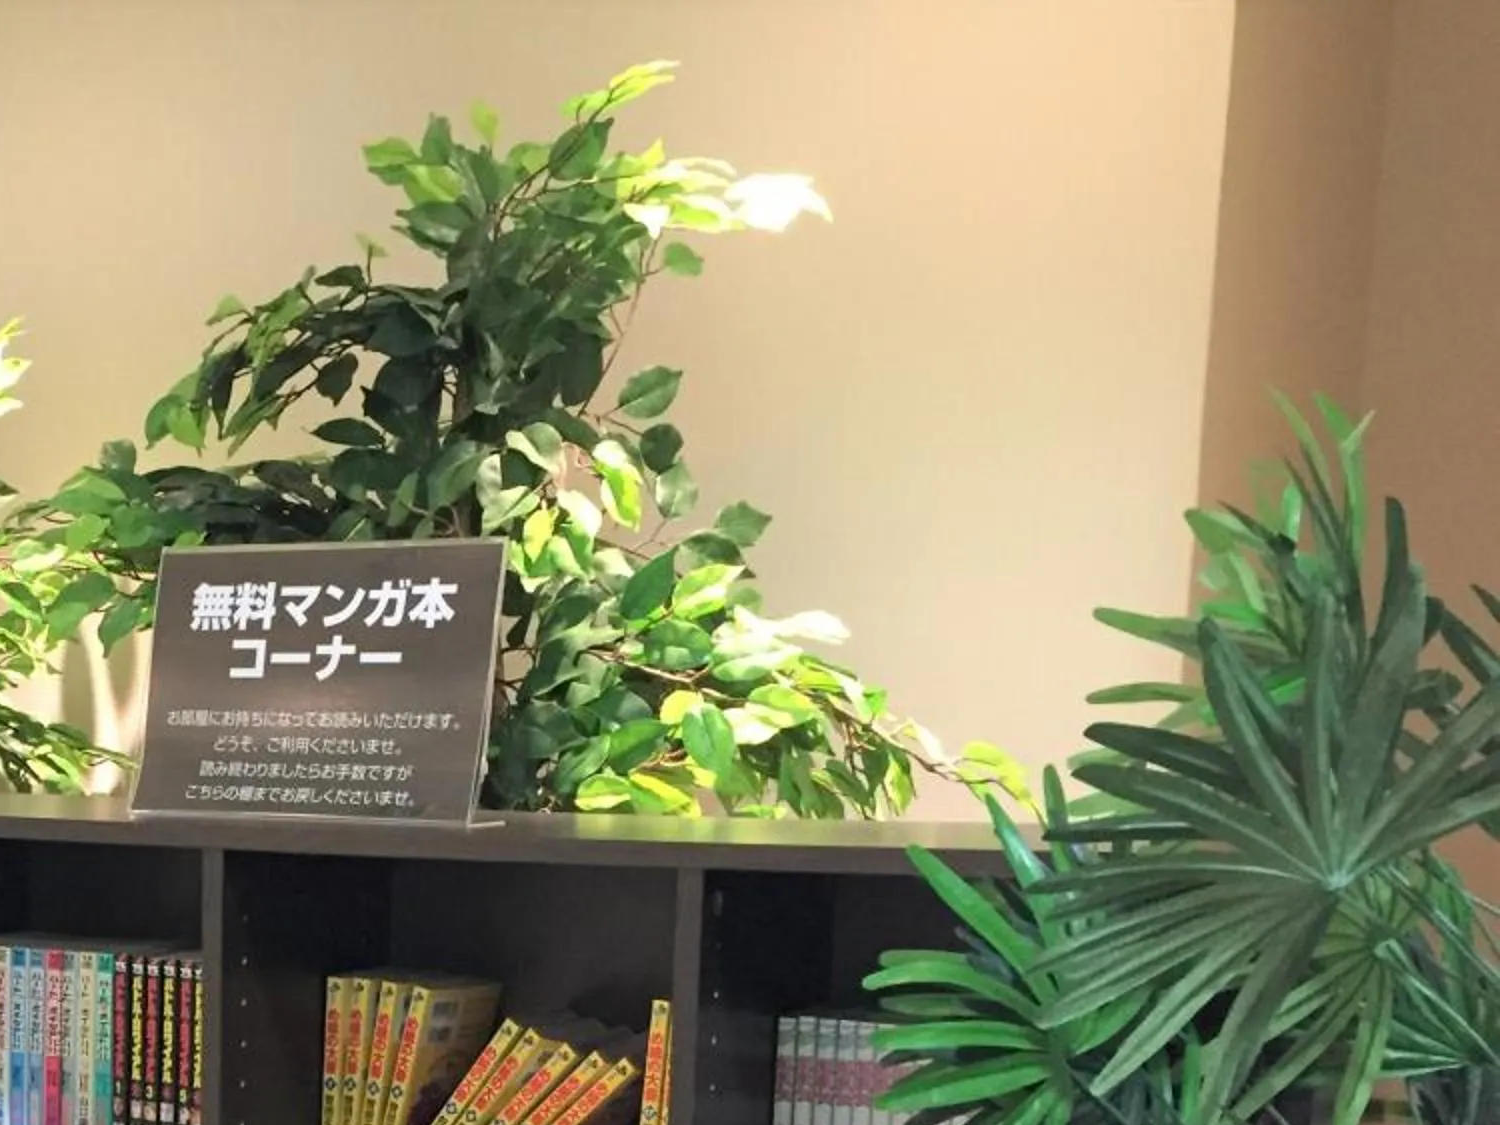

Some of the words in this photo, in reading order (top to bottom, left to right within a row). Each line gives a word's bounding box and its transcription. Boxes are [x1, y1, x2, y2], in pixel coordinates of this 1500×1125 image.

[190, 577, 458, 632] 無料マンガ本
[229, 635, 403, 682] コーナー
